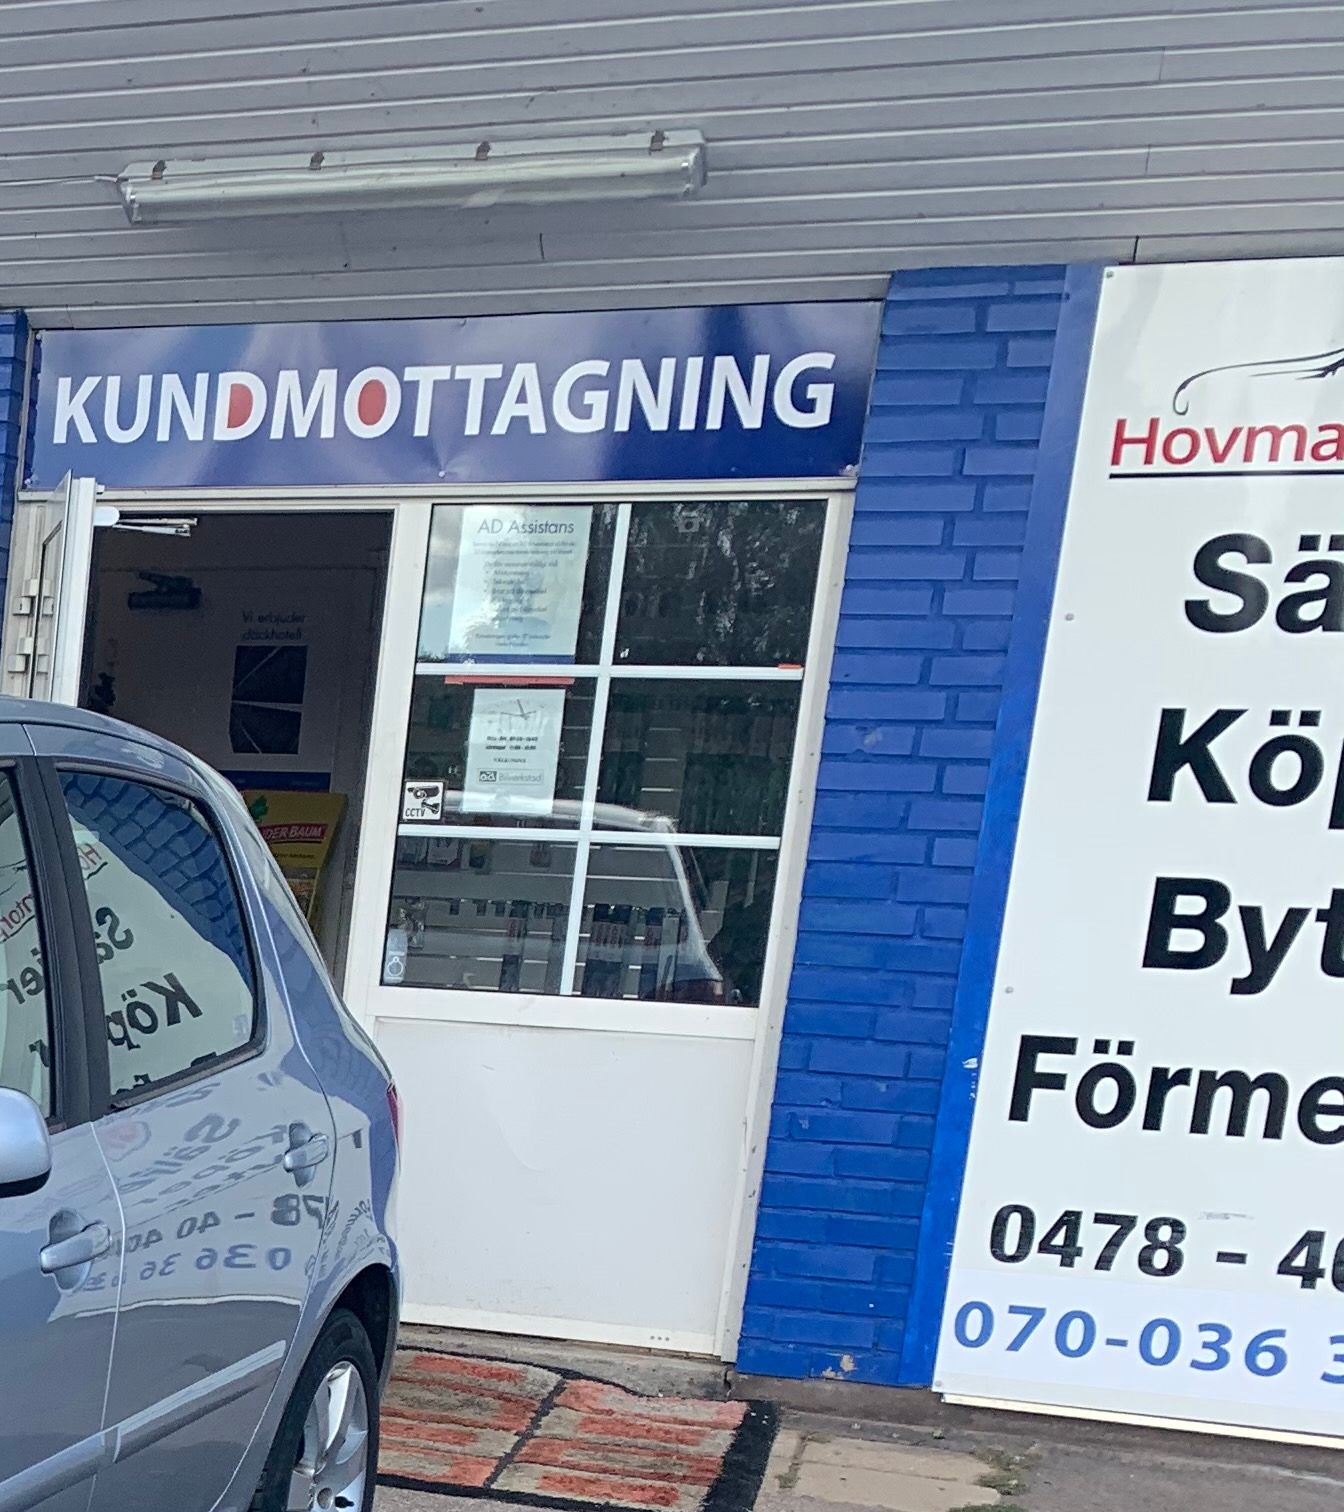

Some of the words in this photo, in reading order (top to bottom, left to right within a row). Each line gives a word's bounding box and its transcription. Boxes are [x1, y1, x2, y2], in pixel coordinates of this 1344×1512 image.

[52, 351, 838, 446] KUNDMOTTAGNING
[1110, 417, 1344, 466] Hovma
[477, 518, 503, 534] AD
[507, 518, 575, 534] Assistans
[1184, 532, 1344, 634] Sä
[405, 807, 426, 817] CCTV
[1141, 875, 1344, 996] Byt
[1008, 1034, 1344, 1145] Förme
[989, 1203, 1188, 1277] 0478
[1276, 1229, 1344, 1293] 4
[954, 1300, 1289, 1378] 070-036
